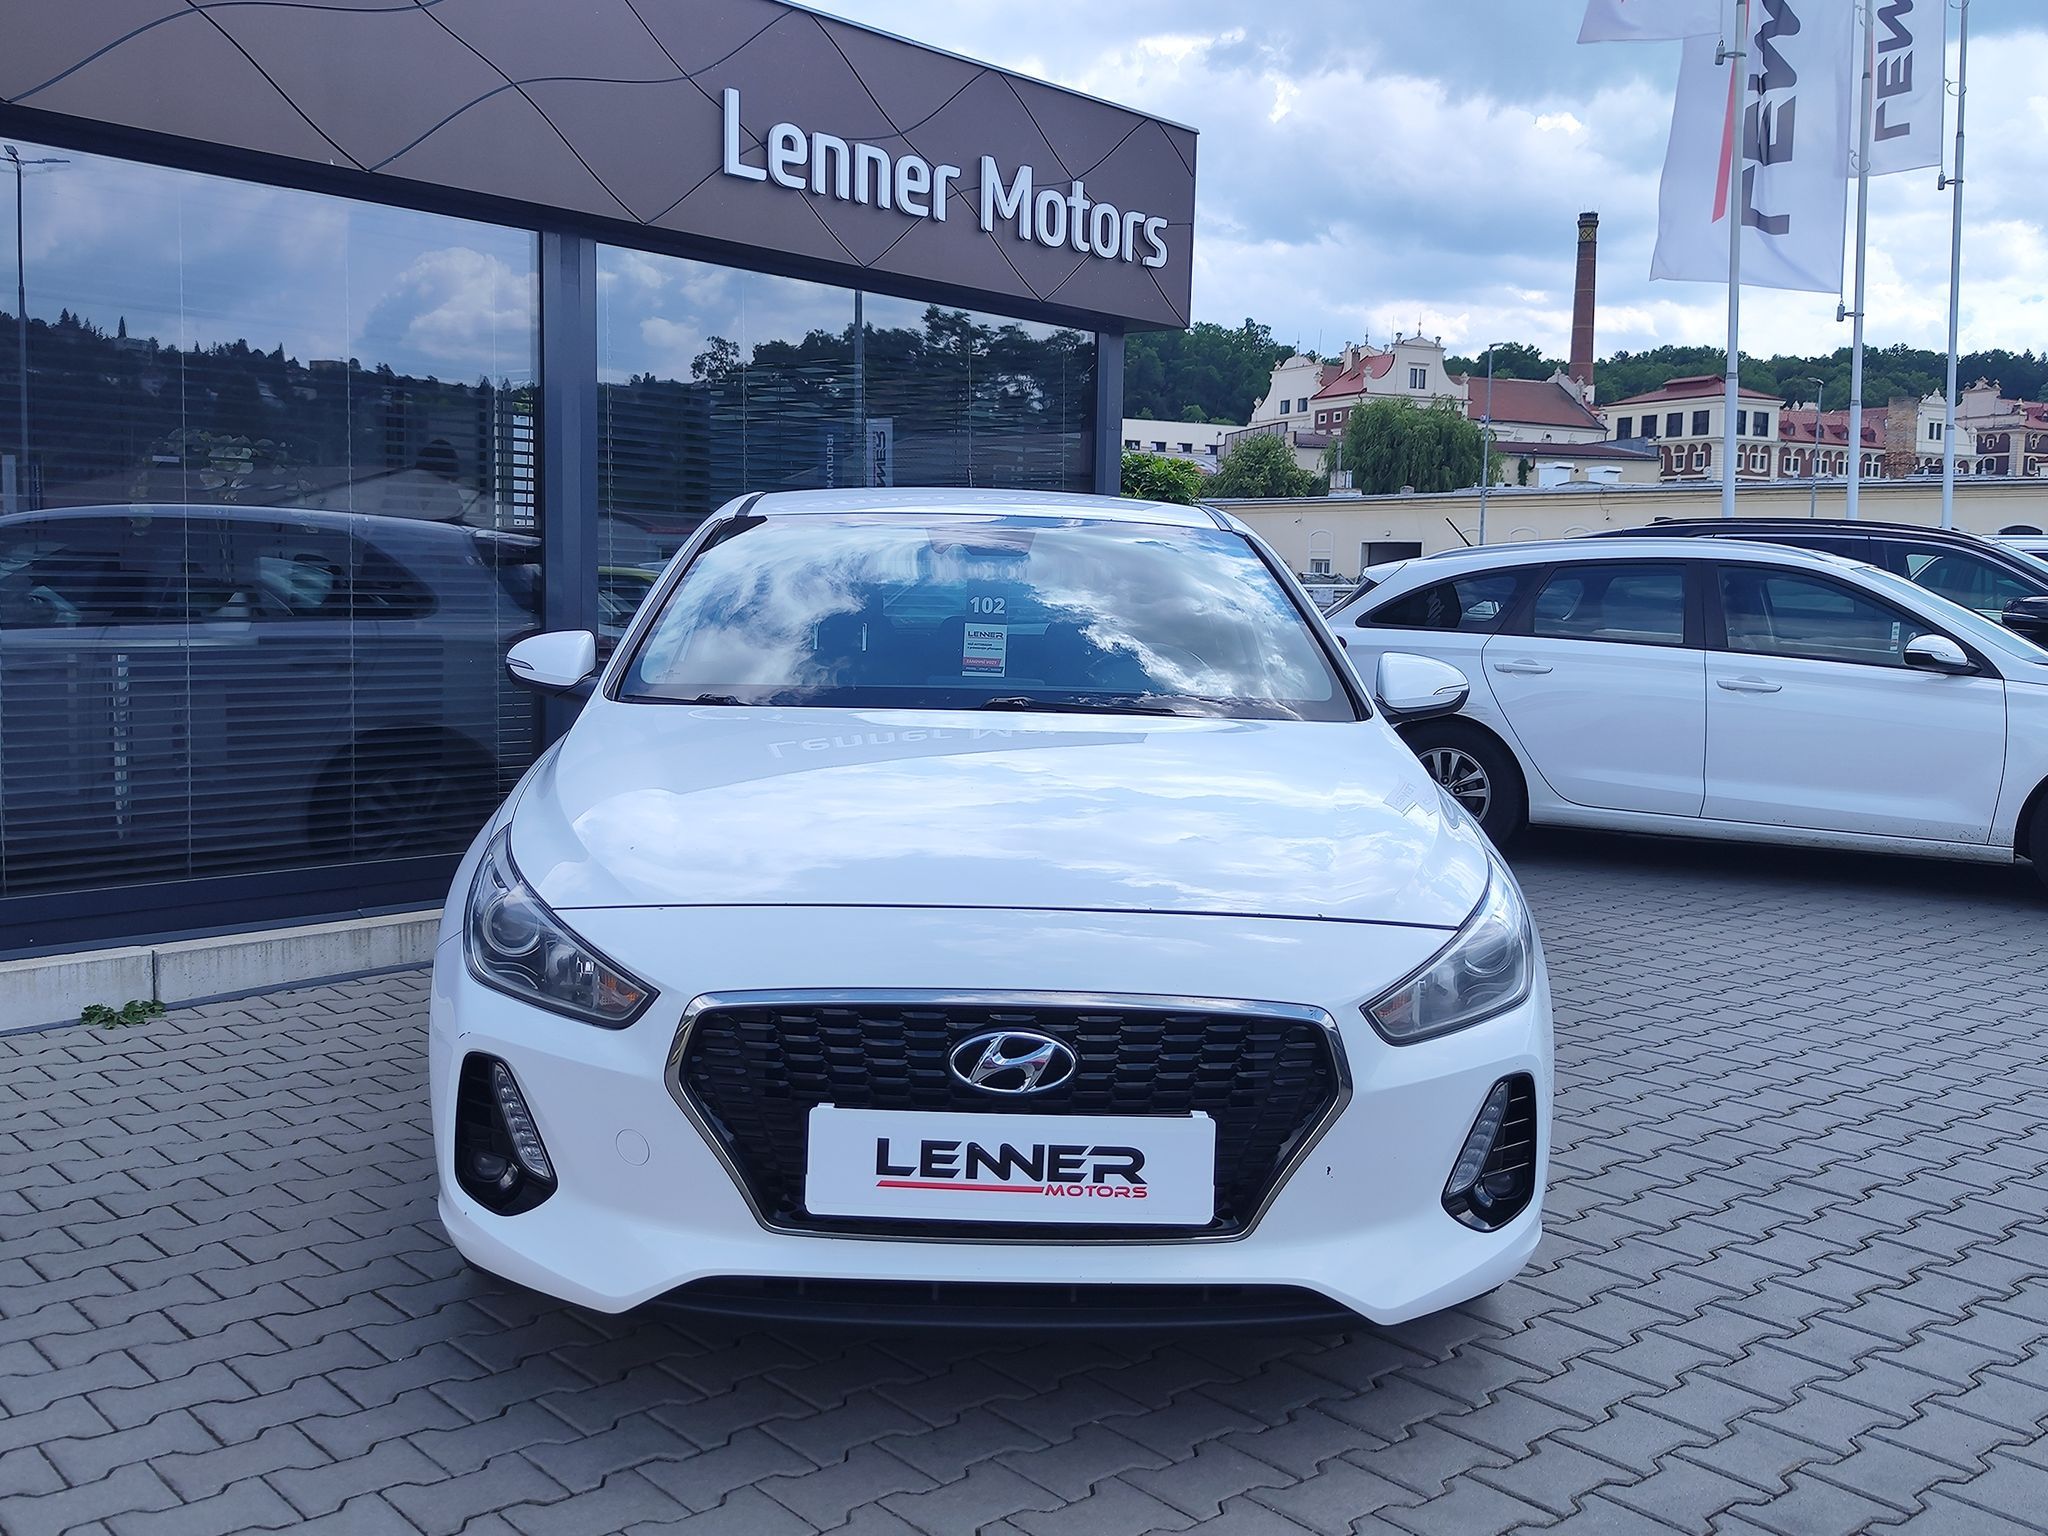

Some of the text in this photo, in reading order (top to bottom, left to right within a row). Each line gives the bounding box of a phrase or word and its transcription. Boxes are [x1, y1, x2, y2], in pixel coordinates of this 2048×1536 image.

[723, 87, 1169, 269] Lenner Motors
[969, 596, 1006, 614] 102
[967, 630, 1004, 640] LENNER
[876, 1137, 1147, 1185] LENNER
[1044, 1184, 1148, 1199] MOTORS
